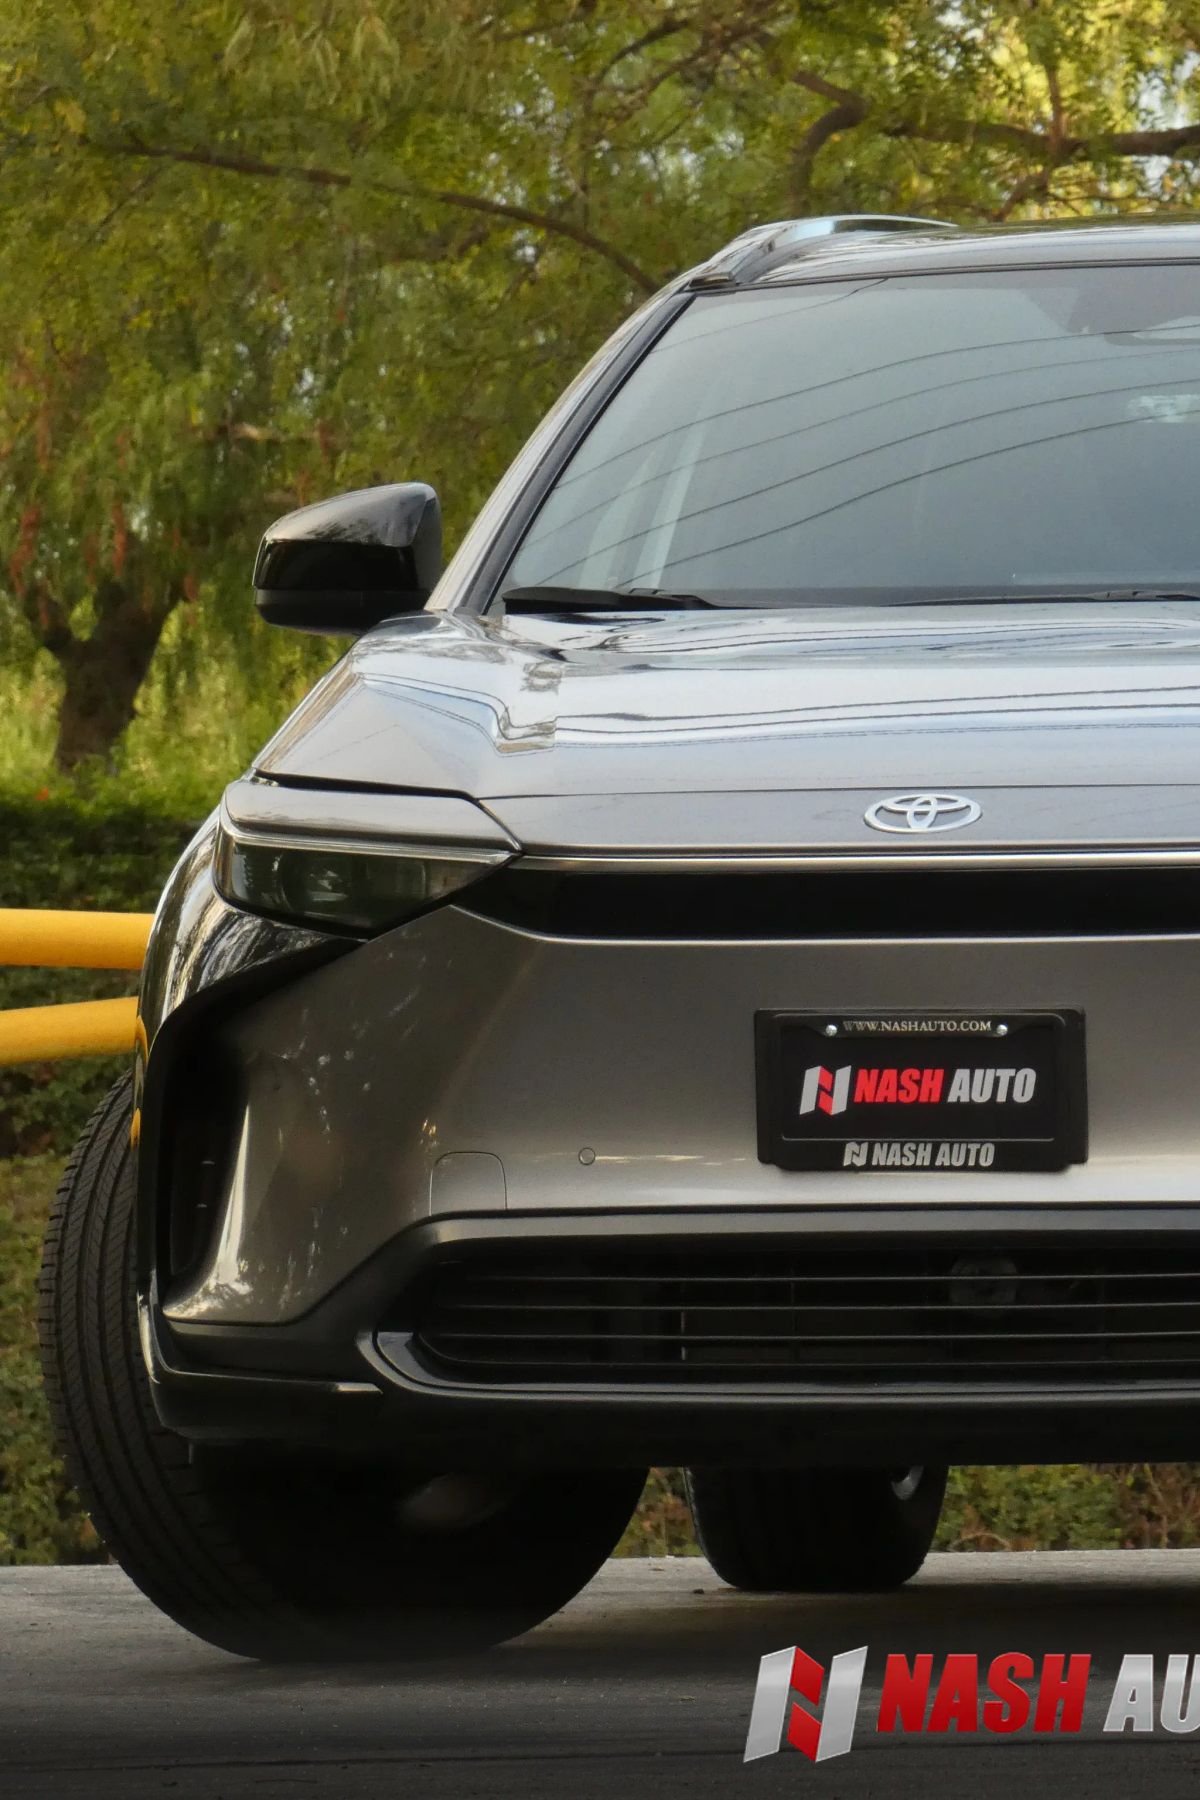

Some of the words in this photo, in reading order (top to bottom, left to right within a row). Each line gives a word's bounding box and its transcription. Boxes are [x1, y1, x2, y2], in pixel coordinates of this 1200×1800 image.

[843, 1020, 992, 1032] WWW.NASHAUTO.COM
[853, 1068, 945, 1104] NASH
[947, 1067, 1037, 1104] AUTO
[871, 1142, 932, 1167] NASH
[934, 1142, 995, 1167] AUTO
